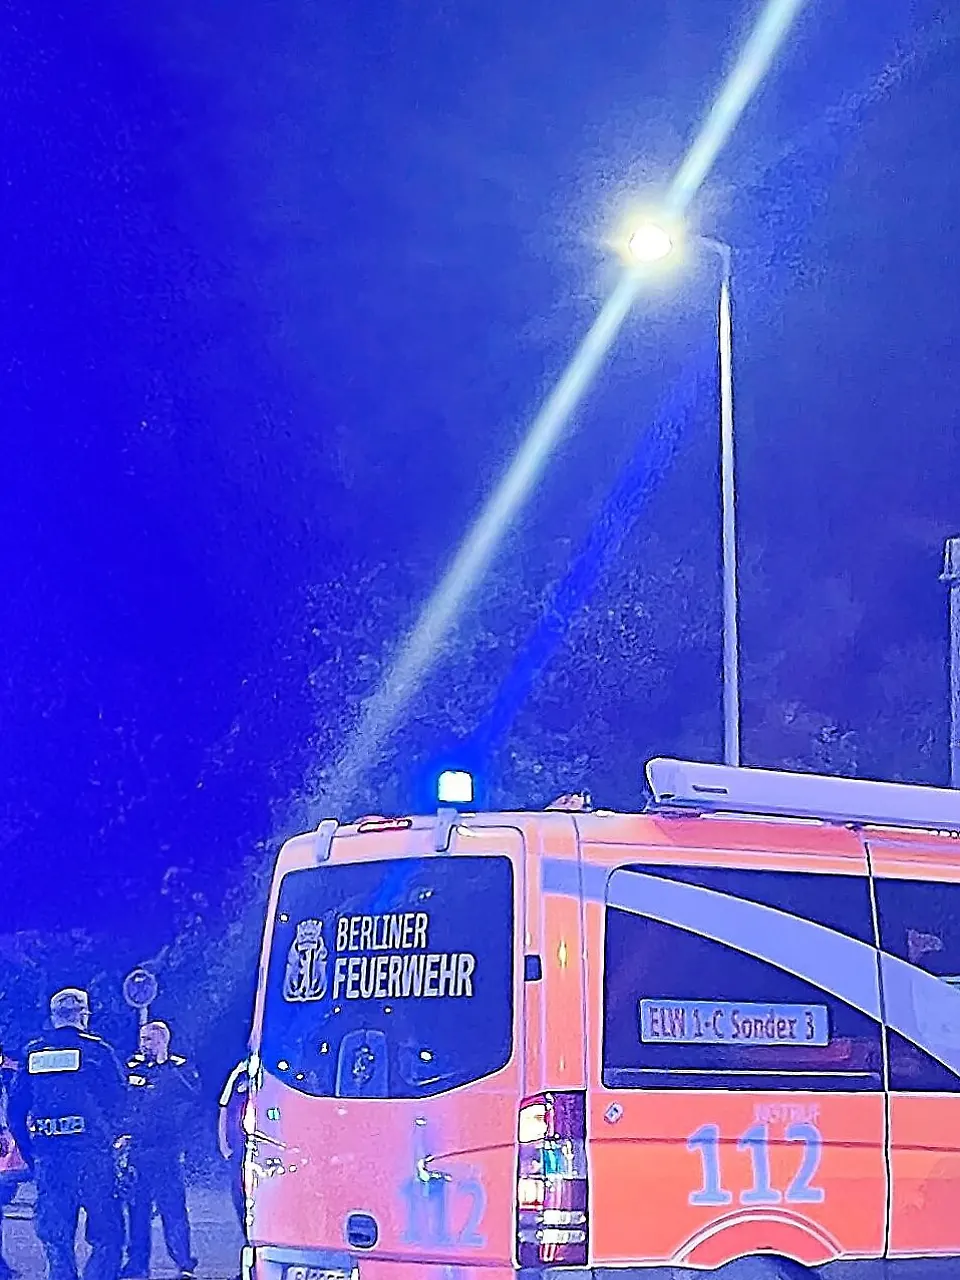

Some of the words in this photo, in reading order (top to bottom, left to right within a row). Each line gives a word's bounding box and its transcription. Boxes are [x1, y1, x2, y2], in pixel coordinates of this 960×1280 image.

[337, 913, 428, 951] BERLINER
[333, 953, 476, 999] FEUERWEHR
[730, 1008, 798, 1039] Sonder
[804, 1011, 815, 1040] 3
[687, 1123, 825, 1205] 112
[401, 1177, 487, 1246] 112
